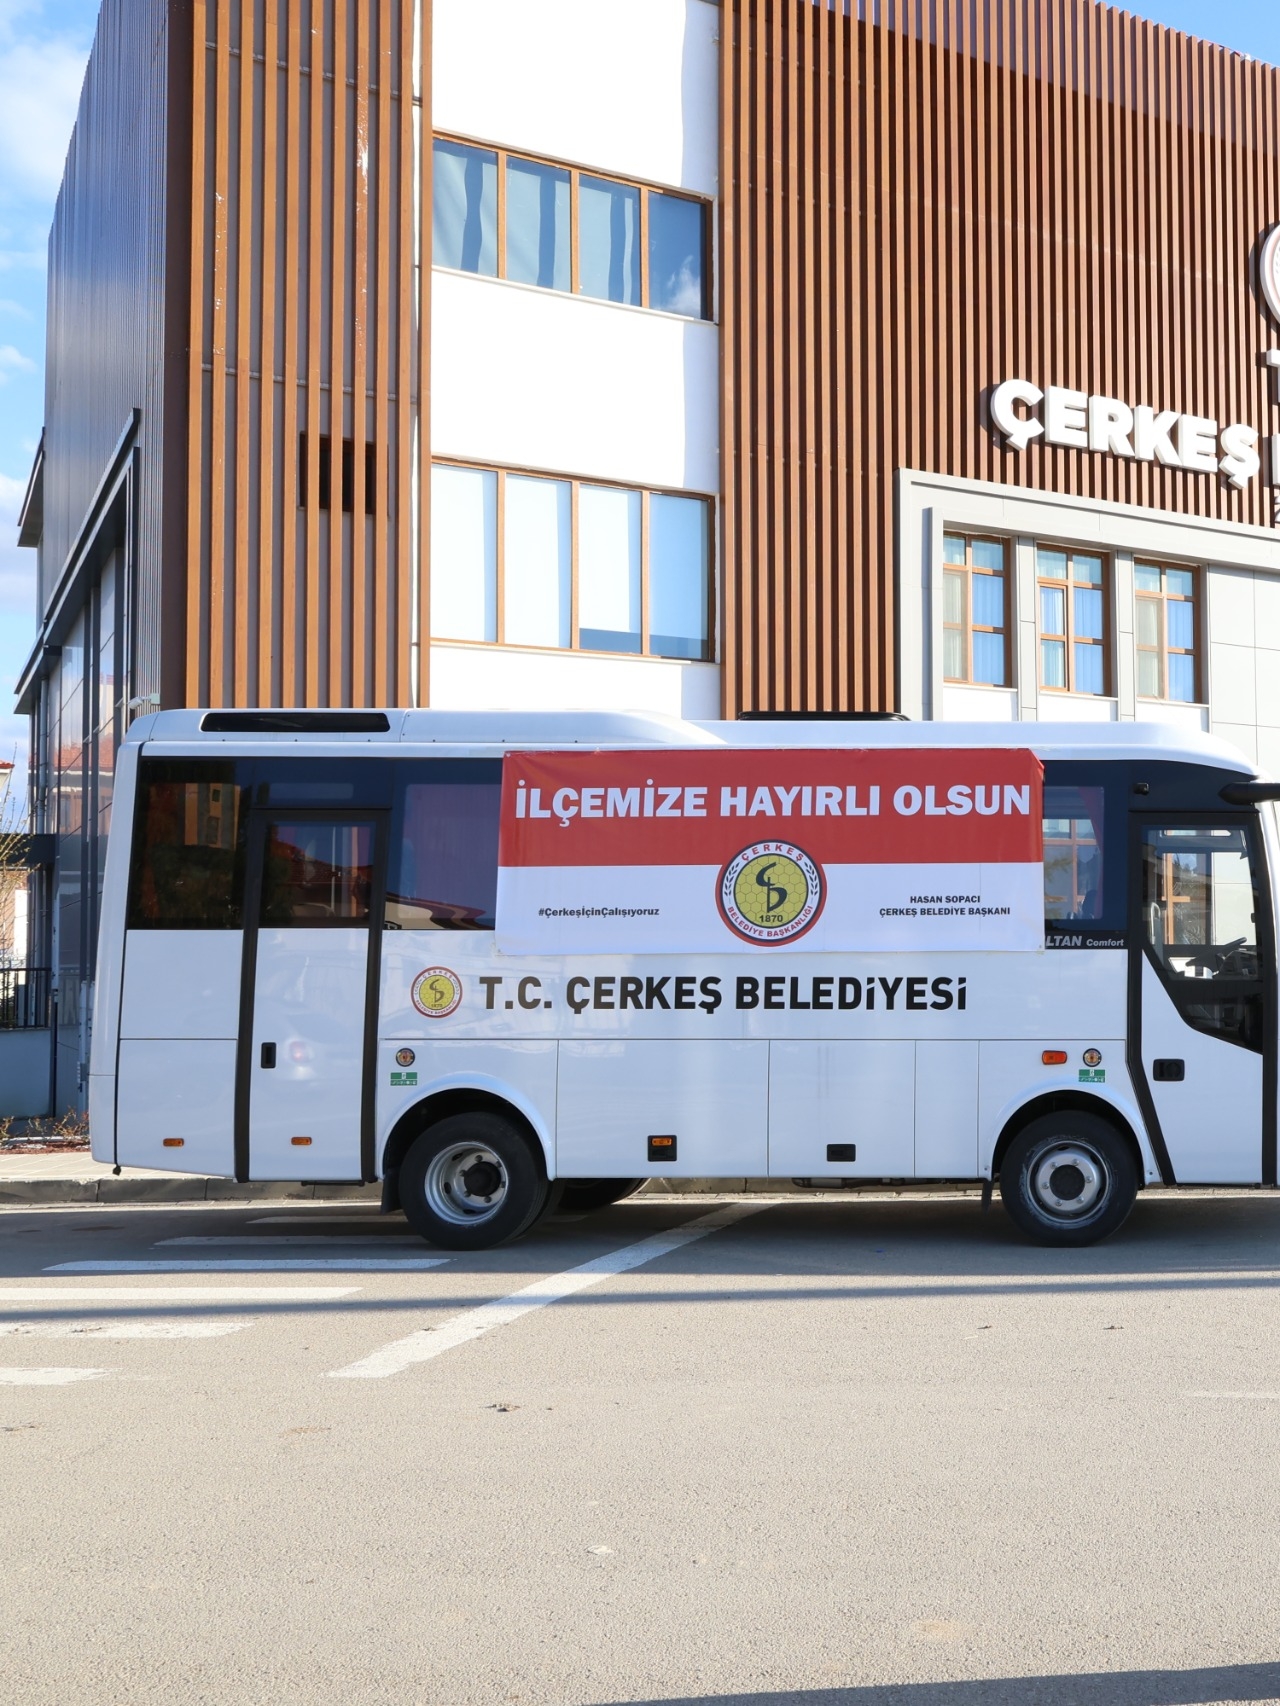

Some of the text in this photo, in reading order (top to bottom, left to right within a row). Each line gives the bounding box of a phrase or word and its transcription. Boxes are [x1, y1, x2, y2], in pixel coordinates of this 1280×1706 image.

[990, 378, 1261, 490] ÇERKEŞ
[515, 778, 1030, 827] İLÇEMİZE HAYIRLI OLSUN
[741, 843, 804, 862] ÇERKEŞ
[910, 895, 981, 904] HASAN SOPACI
[538, 905, 660, 919] #ÇerkeşİçinÇalışıyoruz
[759, 914, 784, 923] 1870
[879, 906, 1011, 918] ÇERKEŞ BELEDİYE BAŞKANI
[727, 905, 814, 938] BELEDİYE BAŞKANLIĞI
[1045, 935, 1124, 947] LTAN Comfort
[479, 976, 967, 1014] T.C. ÇERKEŞ BELEDİYESİ
